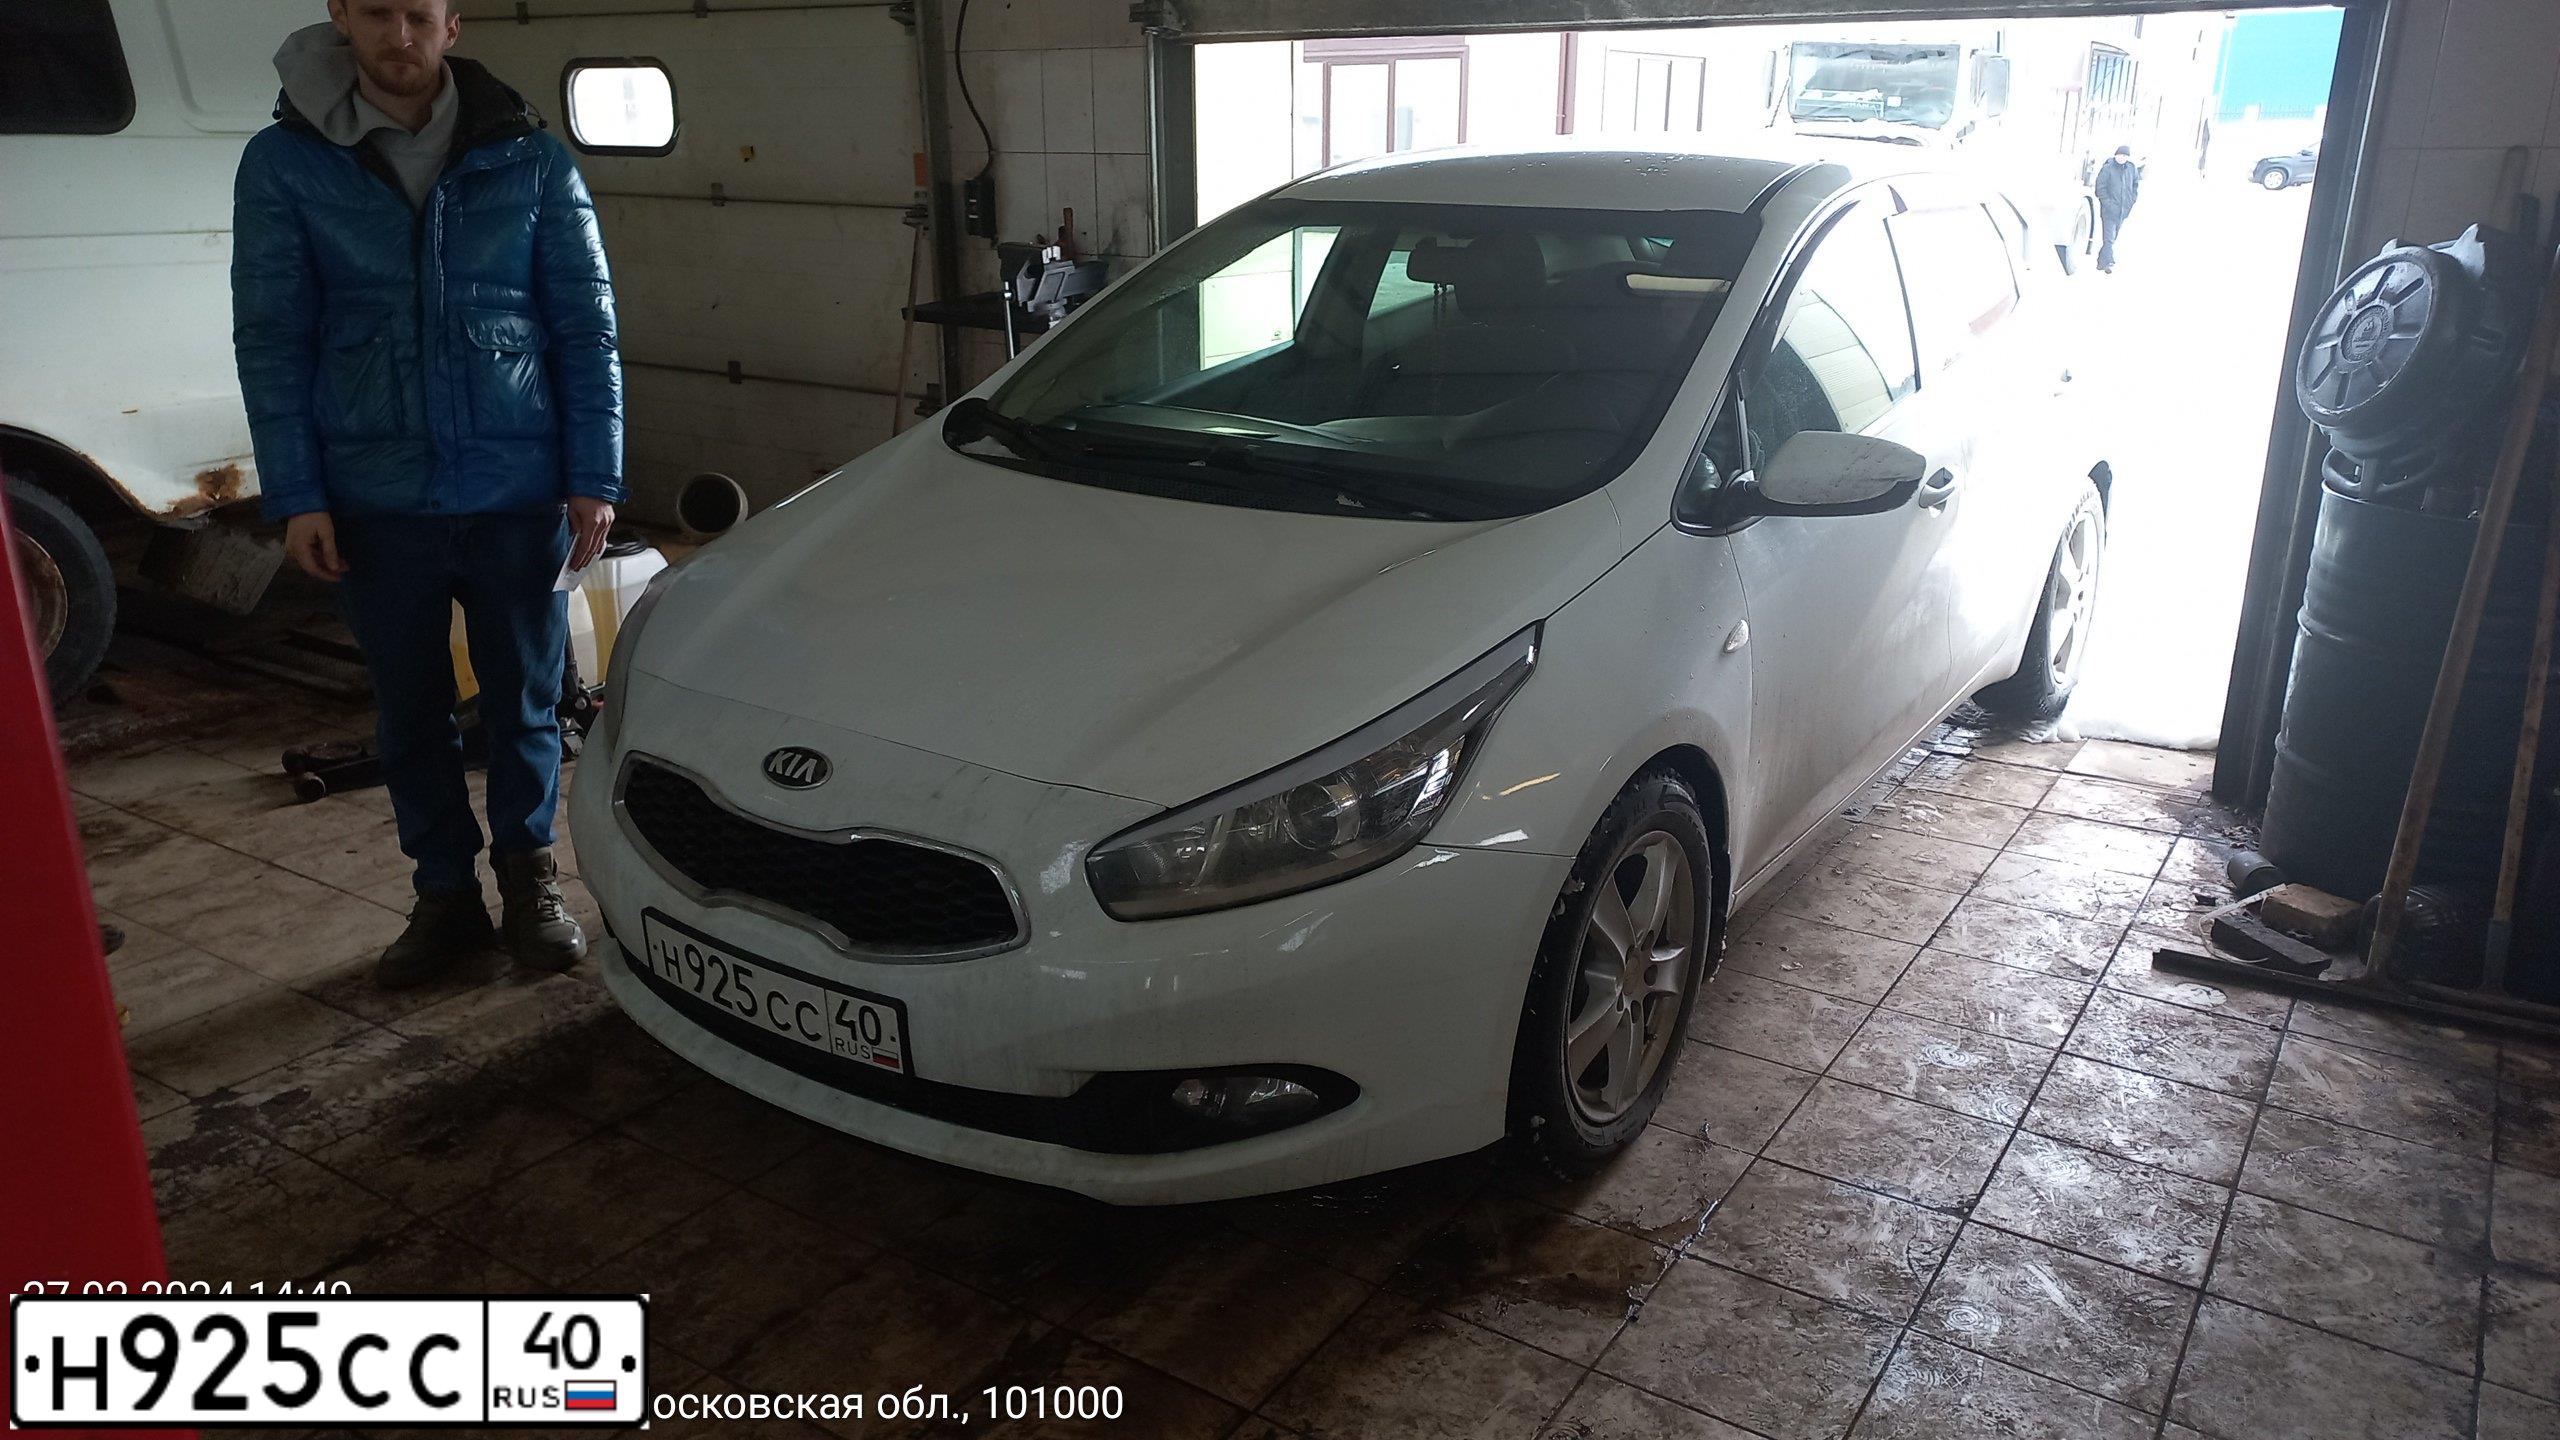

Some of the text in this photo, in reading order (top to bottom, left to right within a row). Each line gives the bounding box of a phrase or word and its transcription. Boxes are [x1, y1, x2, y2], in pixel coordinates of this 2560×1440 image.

[768, 750, 818, 783] KIA
[835, 998, 882, 1047] 40
[834, 1037, 871, 1060] RUS
